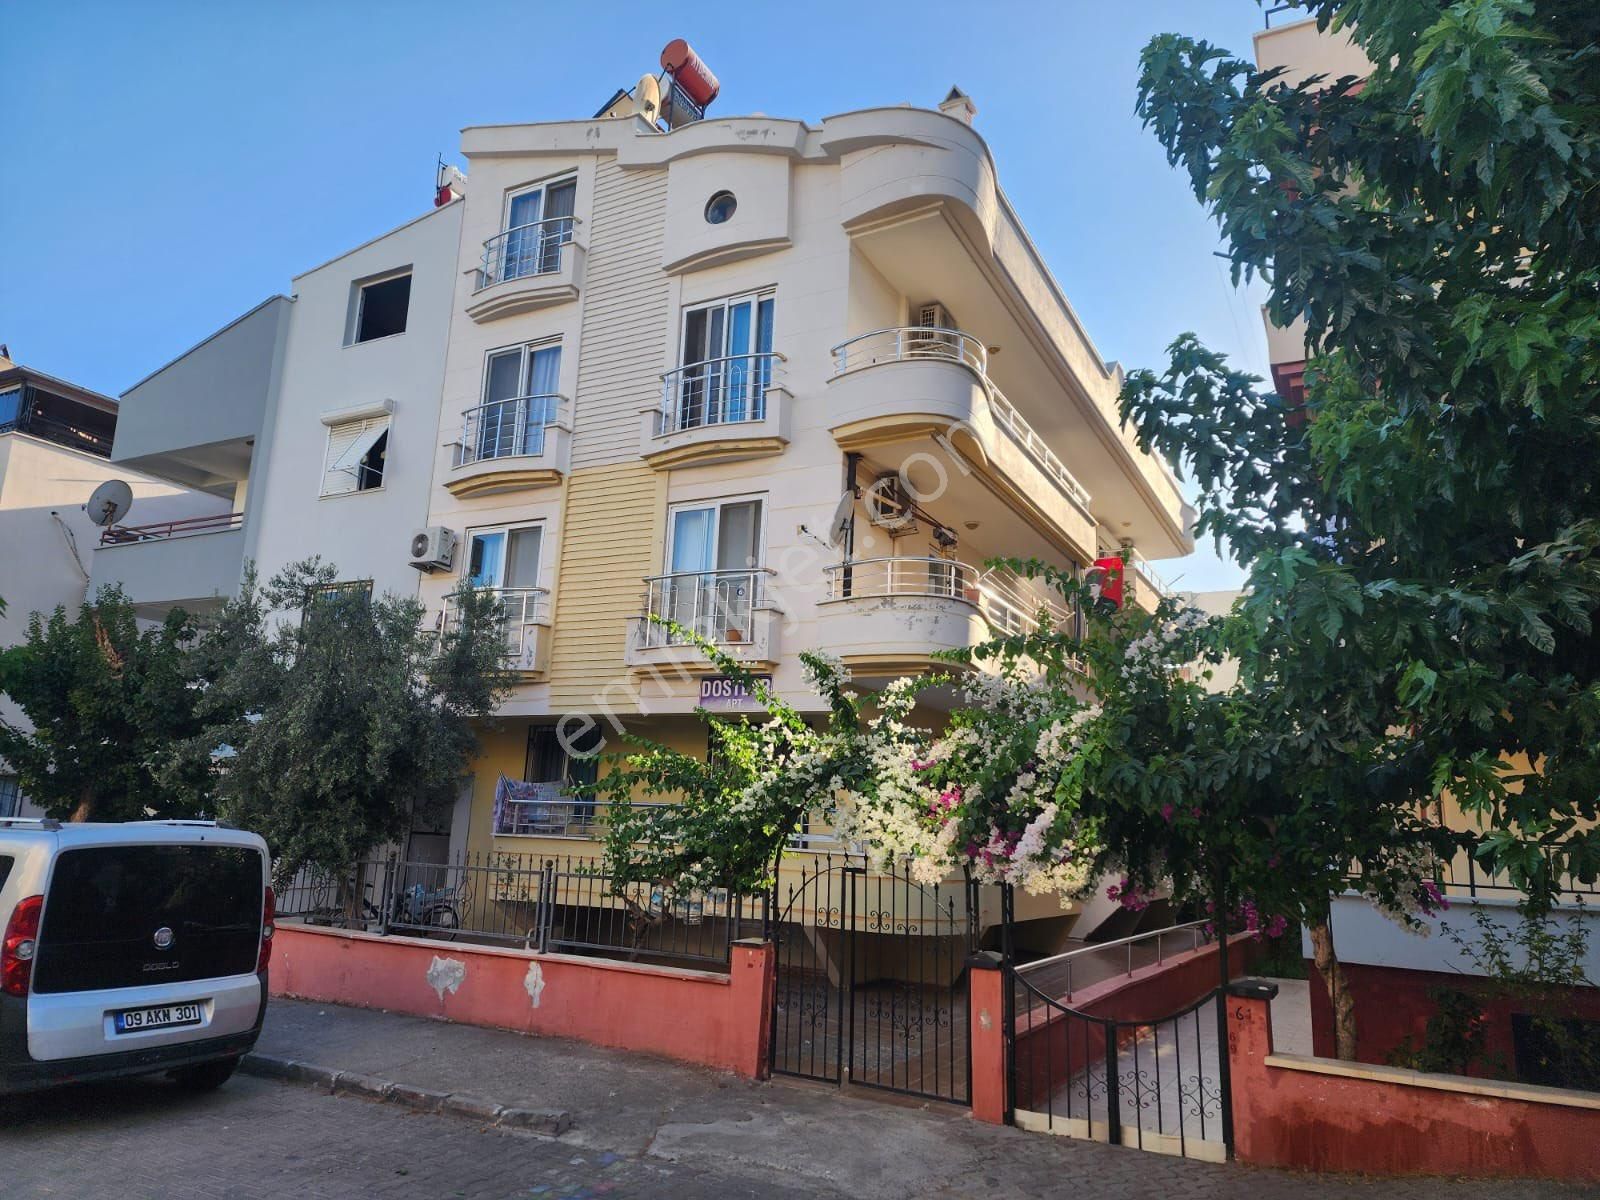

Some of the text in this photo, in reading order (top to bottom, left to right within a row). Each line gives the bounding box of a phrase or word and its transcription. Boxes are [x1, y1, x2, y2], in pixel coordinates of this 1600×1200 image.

[702, 679, 771, 697] DOSTLR
[125, 1006, 197, 1027] 09 AKN 301
